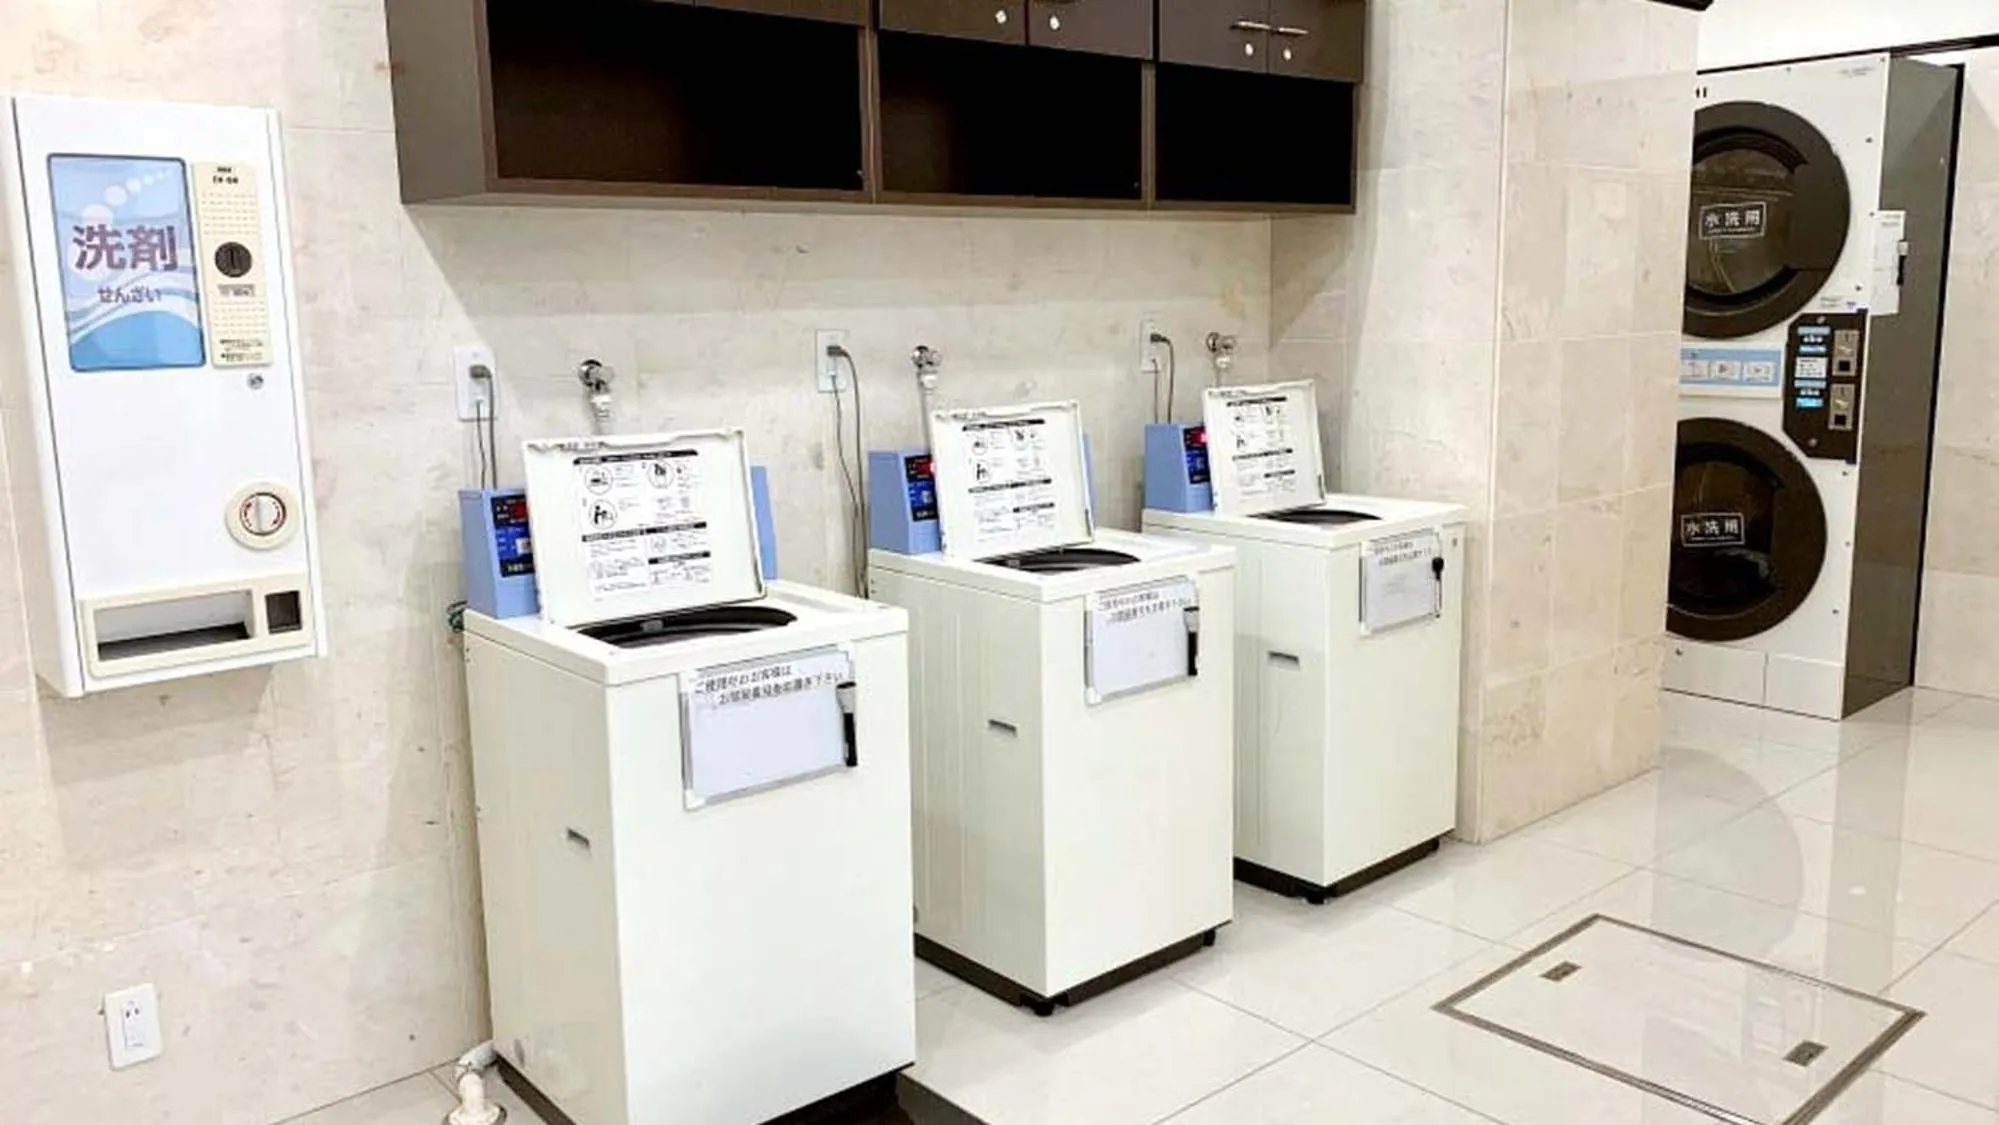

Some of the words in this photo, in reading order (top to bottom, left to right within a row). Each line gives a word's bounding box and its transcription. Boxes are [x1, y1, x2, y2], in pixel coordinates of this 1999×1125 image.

[1705, 209, 1761, 228] 水洗用
[72, 223, 179, 272] 洗剤
[98, 285, 162, 304] せんざい
